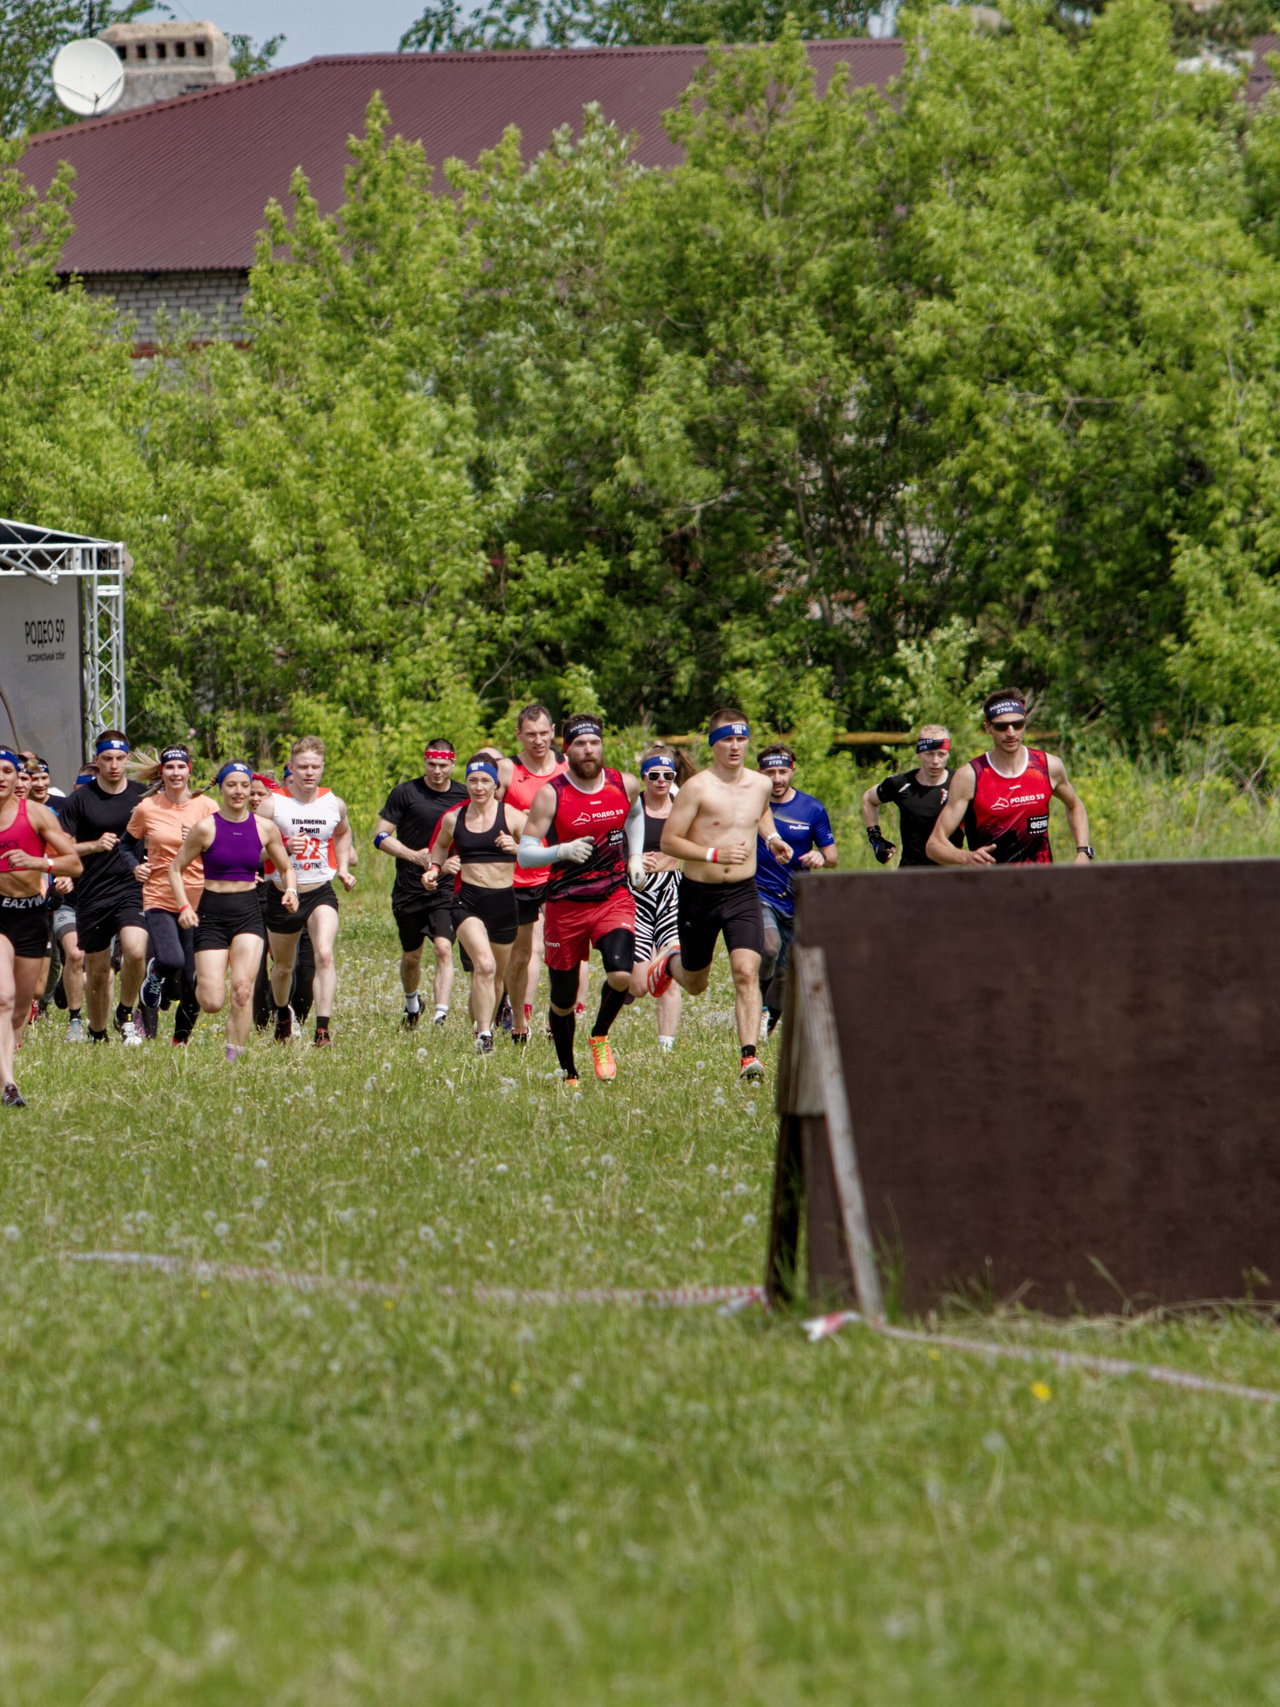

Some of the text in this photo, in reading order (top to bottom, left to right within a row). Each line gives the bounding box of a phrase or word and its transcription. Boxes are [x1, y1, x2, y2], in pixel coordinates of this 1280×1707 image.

[24, 618, 65, 648] РОДЕО 59
[1010, 795, 1036, 804] РОДЕО
[592, 810, 615, 819] РОДЕО
